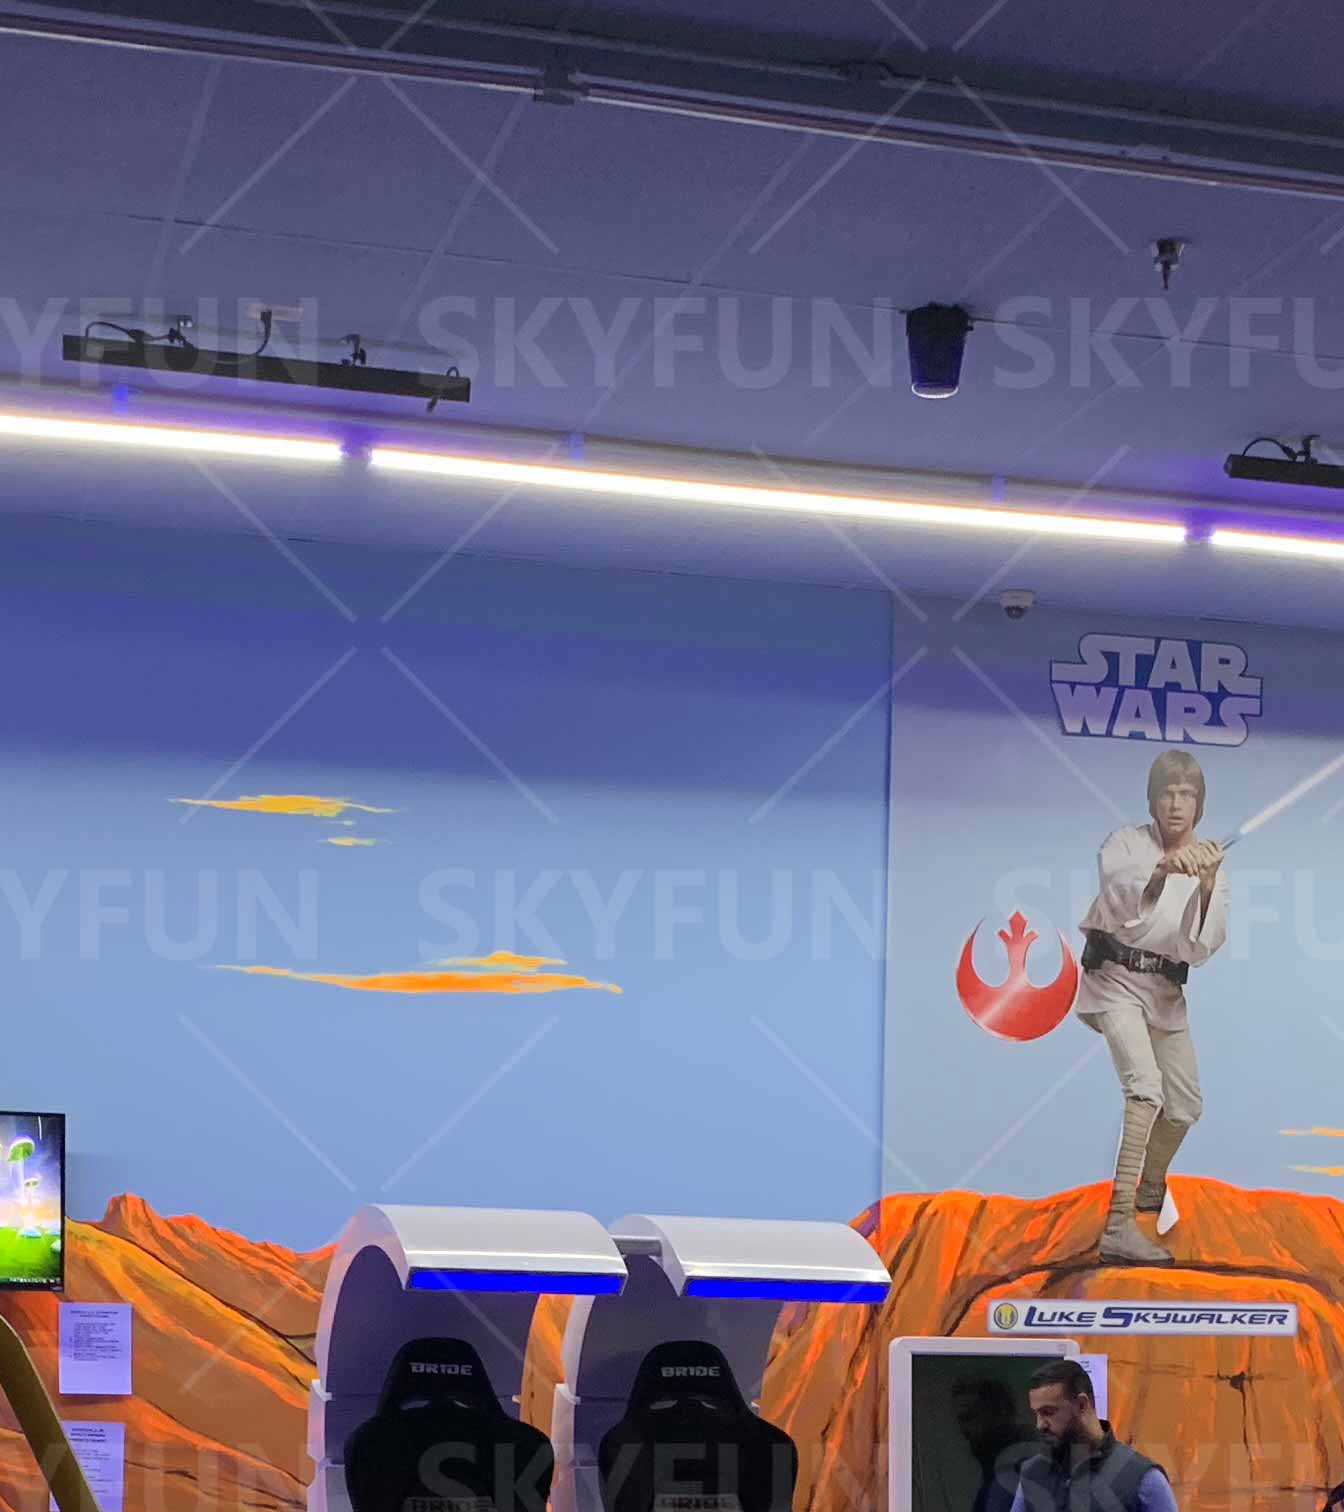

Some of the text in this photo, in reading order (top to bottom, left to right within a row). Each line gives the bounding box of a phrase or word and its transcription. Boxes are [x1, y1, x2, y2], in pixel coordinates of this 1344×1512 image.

[1051, 632, 1263, 696] STAR
[1050, 682, 1263, 747] WARS
[1024, 1306, 1289, 1328] LUKE SKYWALKER
[409, 1361, 473, 1376] BRIDE
[660, 1365, 721, 1377] BRIDE
